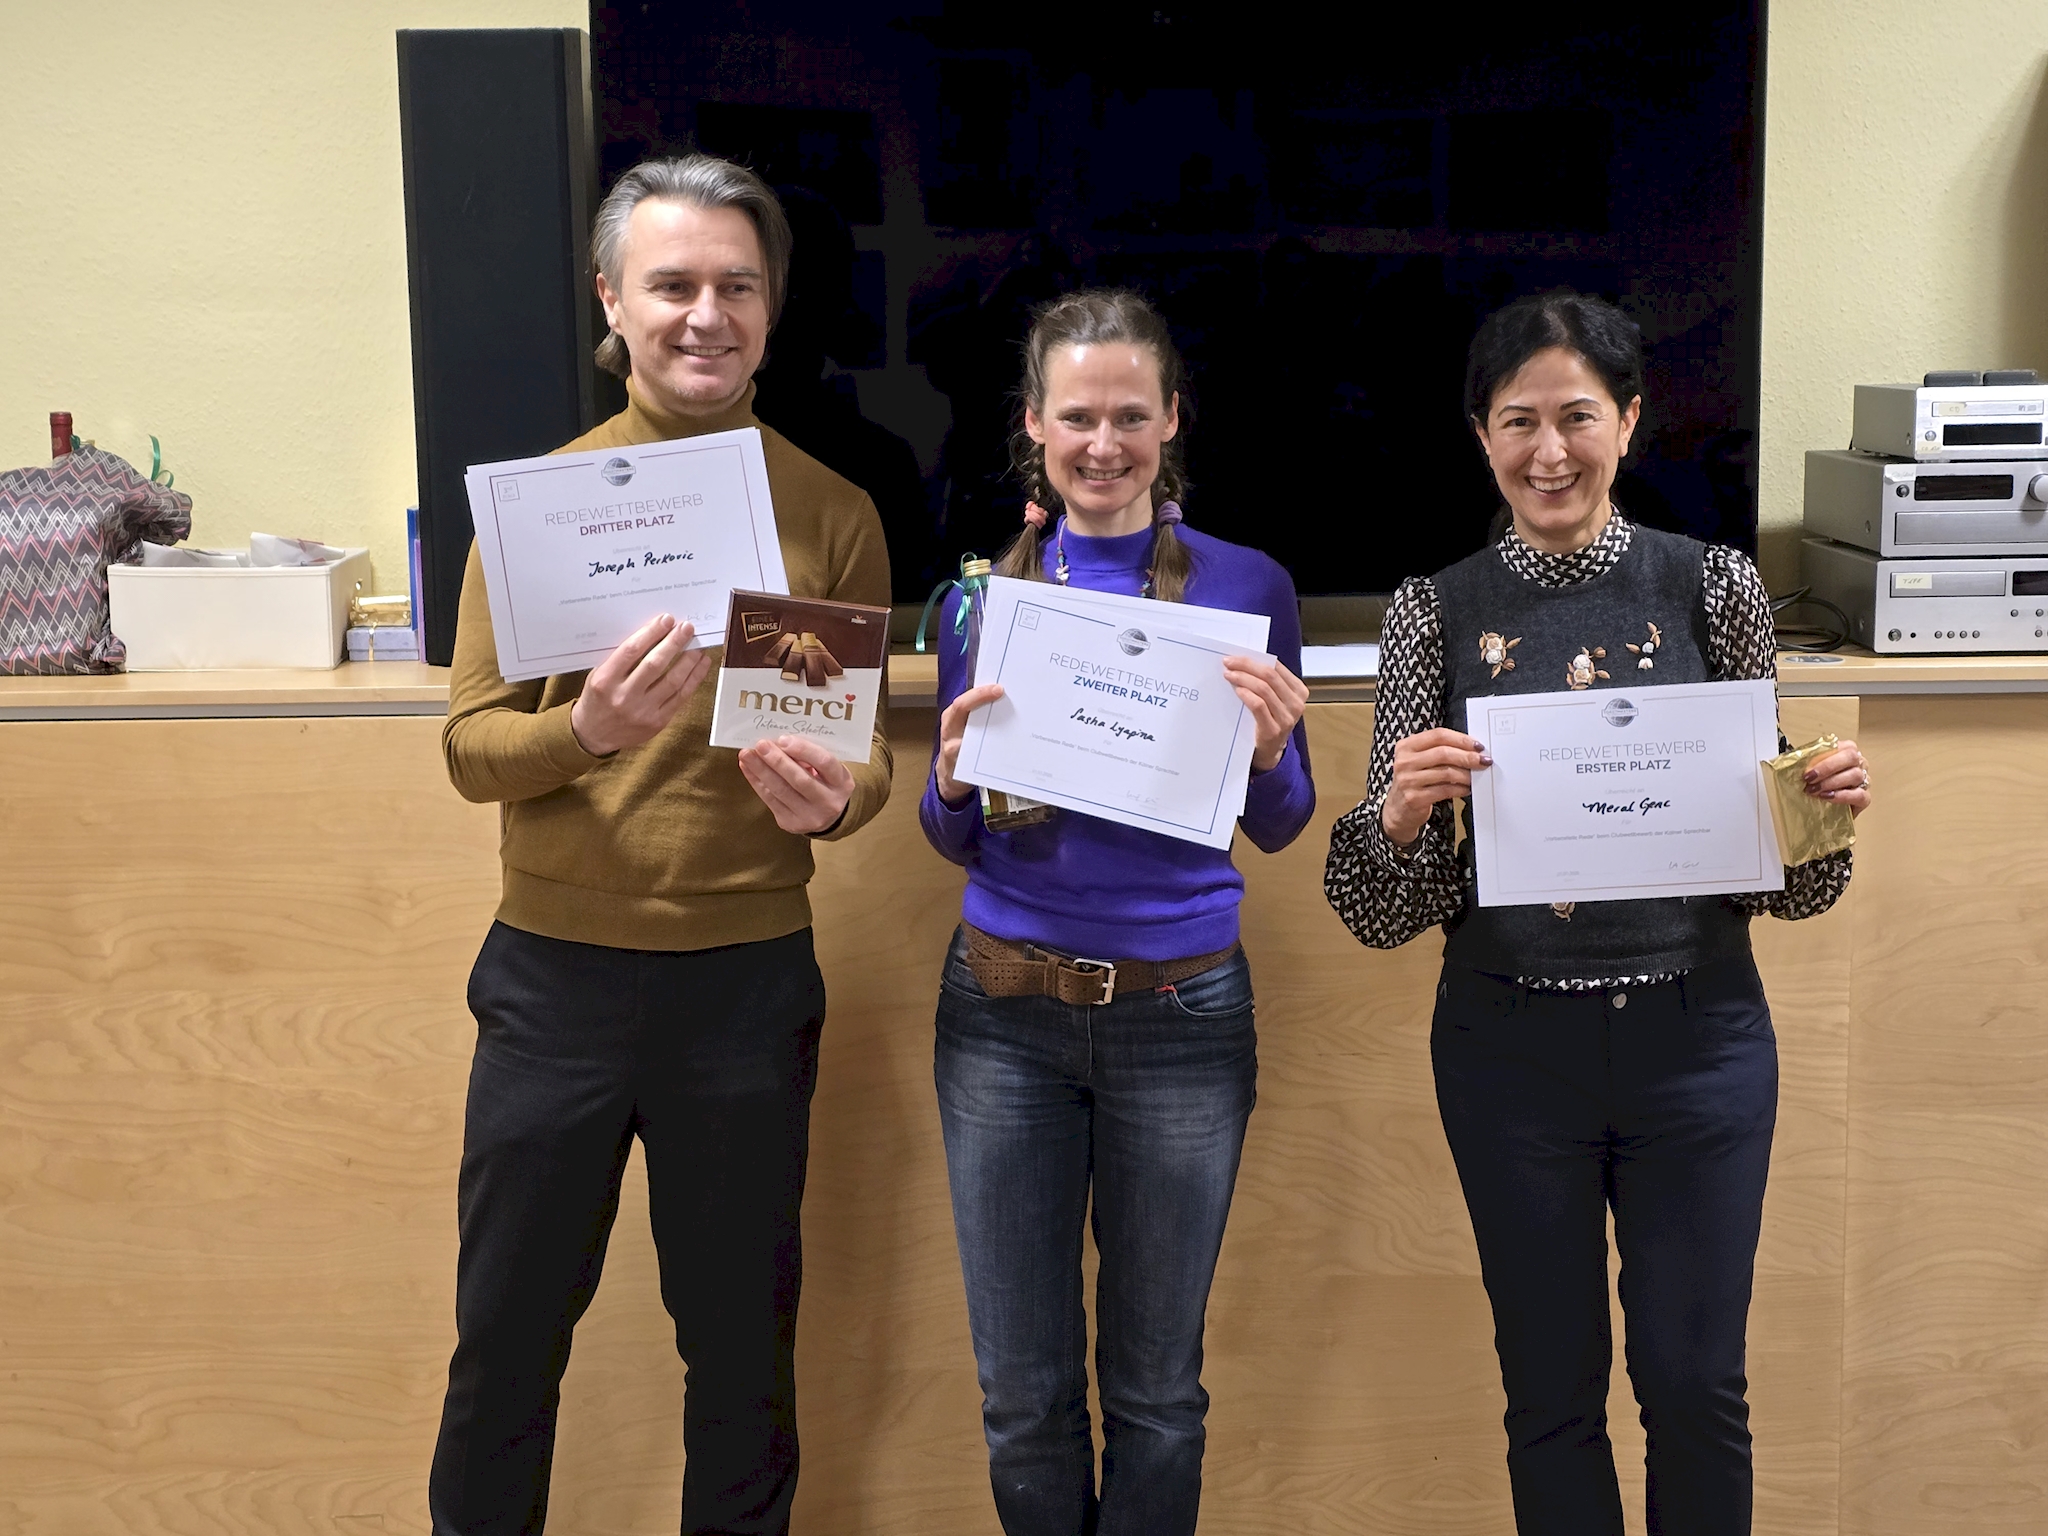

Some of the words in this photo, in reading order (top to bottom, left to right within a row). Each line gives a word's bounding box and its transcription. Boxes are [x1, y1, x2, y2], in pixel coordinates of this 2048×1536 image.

[545, 492, 704, 526] REDEWETTBEWERB
[579, 519, 633, 536] DRITTER
[636, 514, 675, 529] PLATZ
[747, 622, 779, 632] INTENSE
[1049, 652, 1200, 702] REDEWETTBEWERB
[1073, 674, 1129, 699] ZWEITER
[1130, 690, 1169, 709] PLATZ
[738, 690, 857, 721] merci
[752, 714, 790, 731] Intense
[788, 719, 836, 736] Selection
[1070, 707, 1106, 728] Sasha
[1109, 721, 1157, 743] Lyapina
[1539, 739, 1707, 762] REDEWETTBEWERB
[1576, 762, 1626, 774] ERSTER
[1630, 758, 1671, 773] PLATZ
[1582, 801, 1636, 815] Meral
[1639, 797, 1672, 816] Genc
